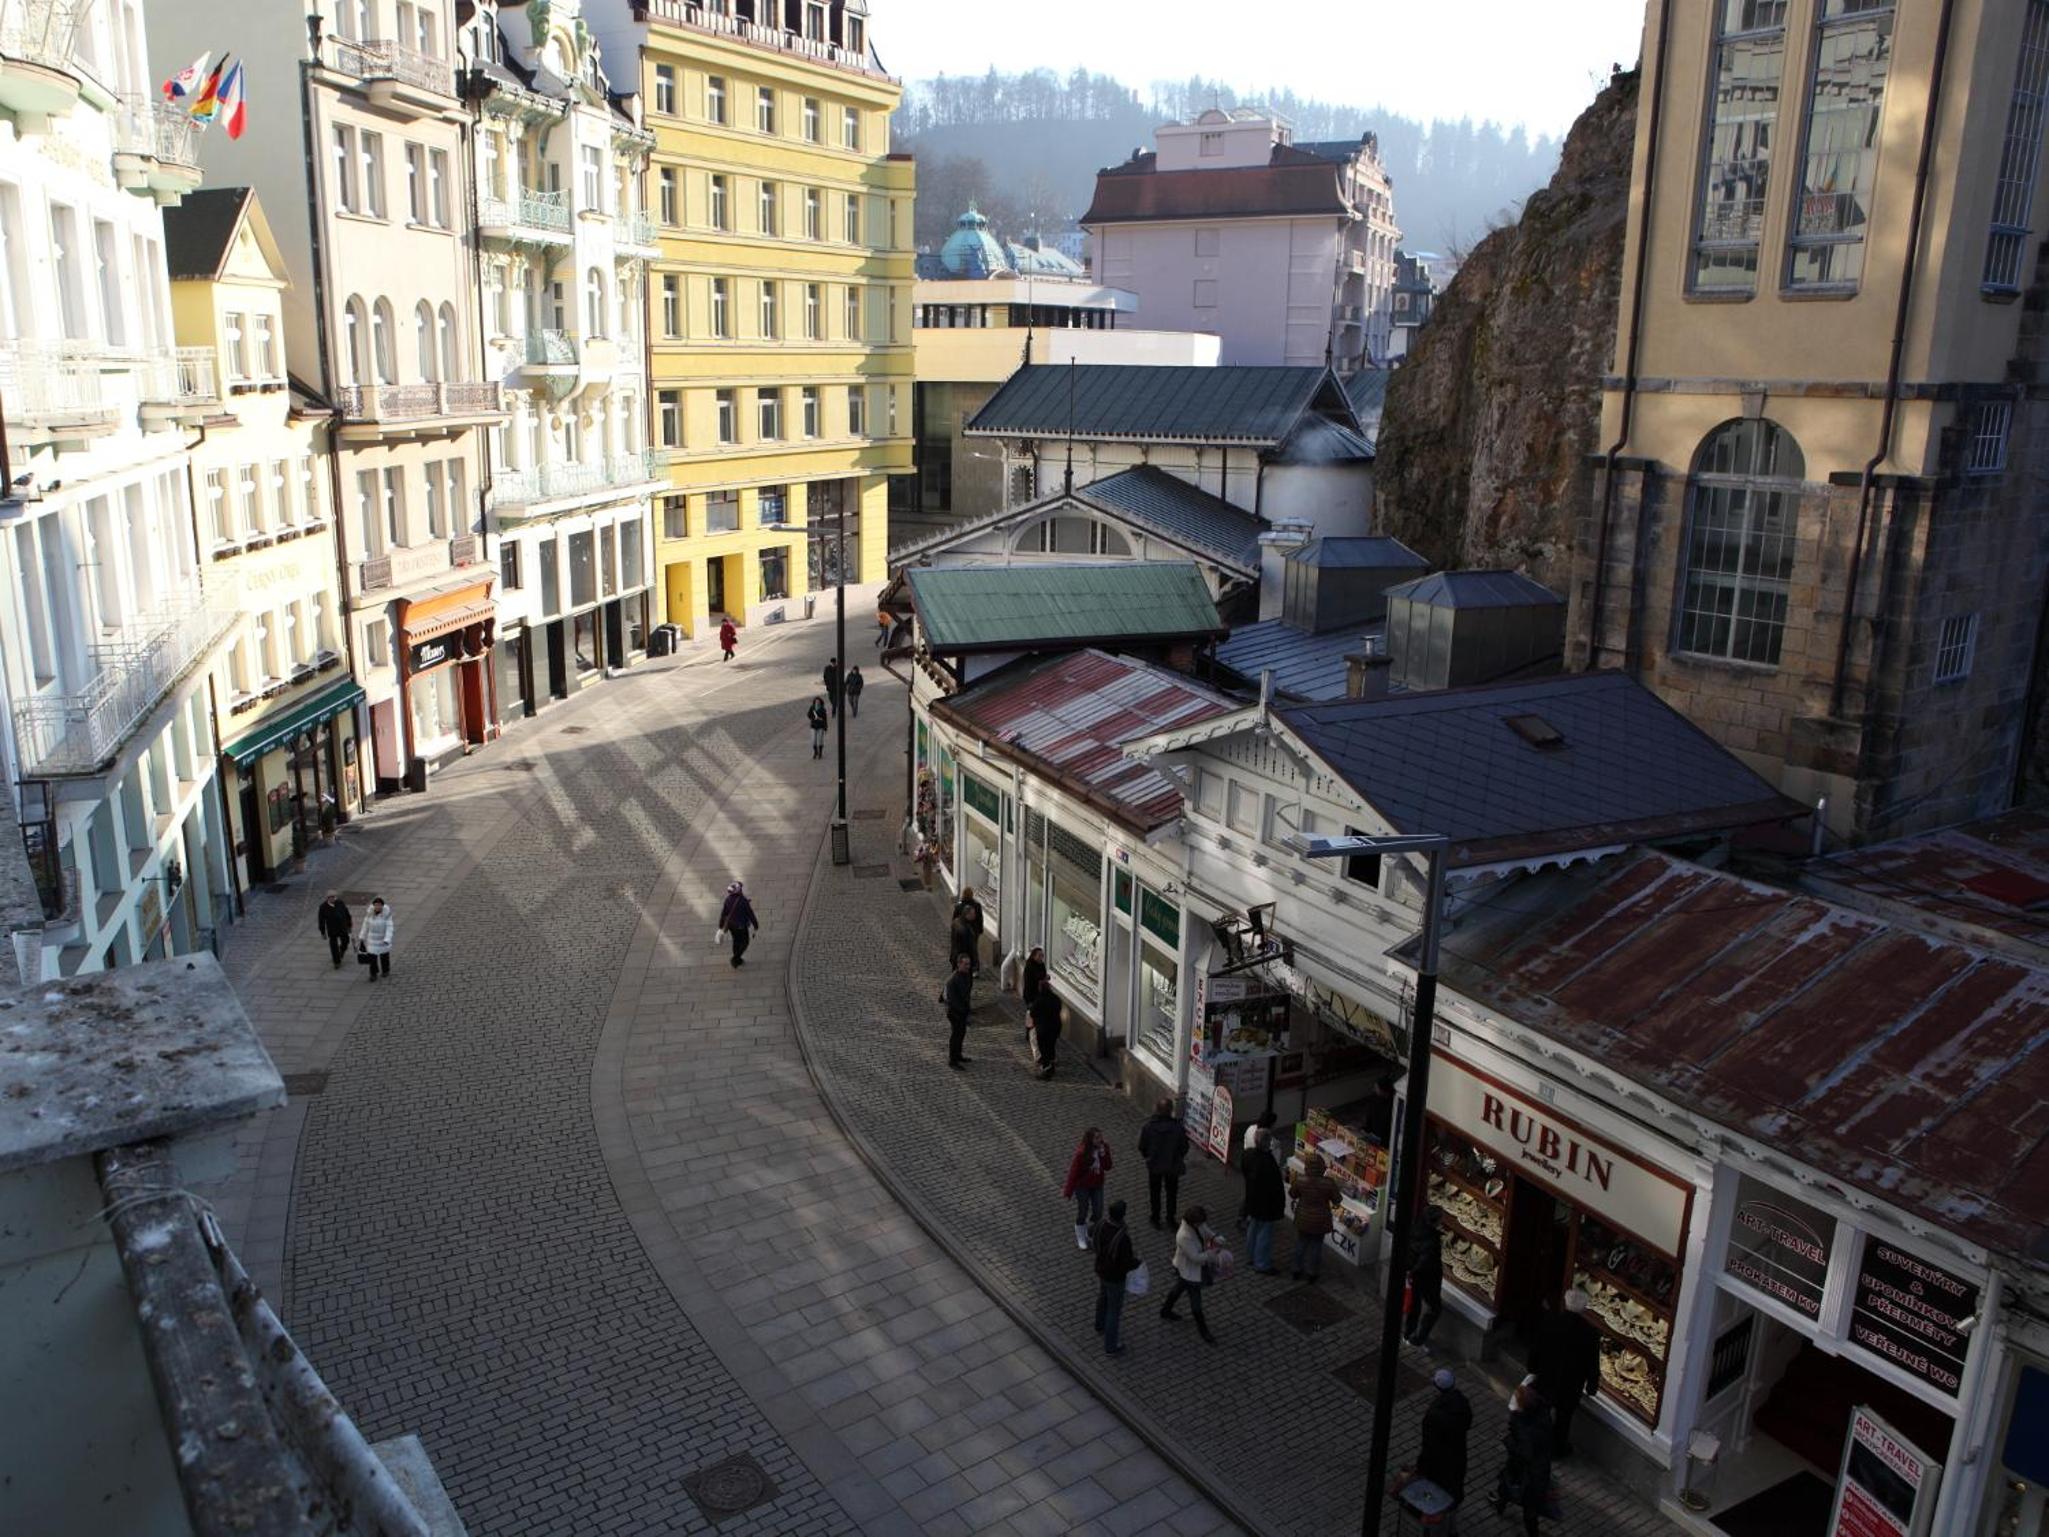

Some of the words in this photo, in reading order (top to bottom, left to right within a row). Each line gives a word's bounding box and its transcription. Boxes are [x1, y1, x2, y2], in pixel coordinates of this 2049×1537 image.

[1480, 1092, 1614, 1193] RUBIN
[1520, 1147, 1563, 1180] jewellery
[1331, 1229, 1358, 1257] CZK
[1876, 1245, 1968, 1298] SUVENÝRY
[1910, 1280, 1924, 1295] &
[1867, 1294, 1958, 1347] PŘEDMĚTY
[1855, 1323, 1928, 1373] VEŘEJNÉ
[1929, 1363, 1958, 1388] WC
